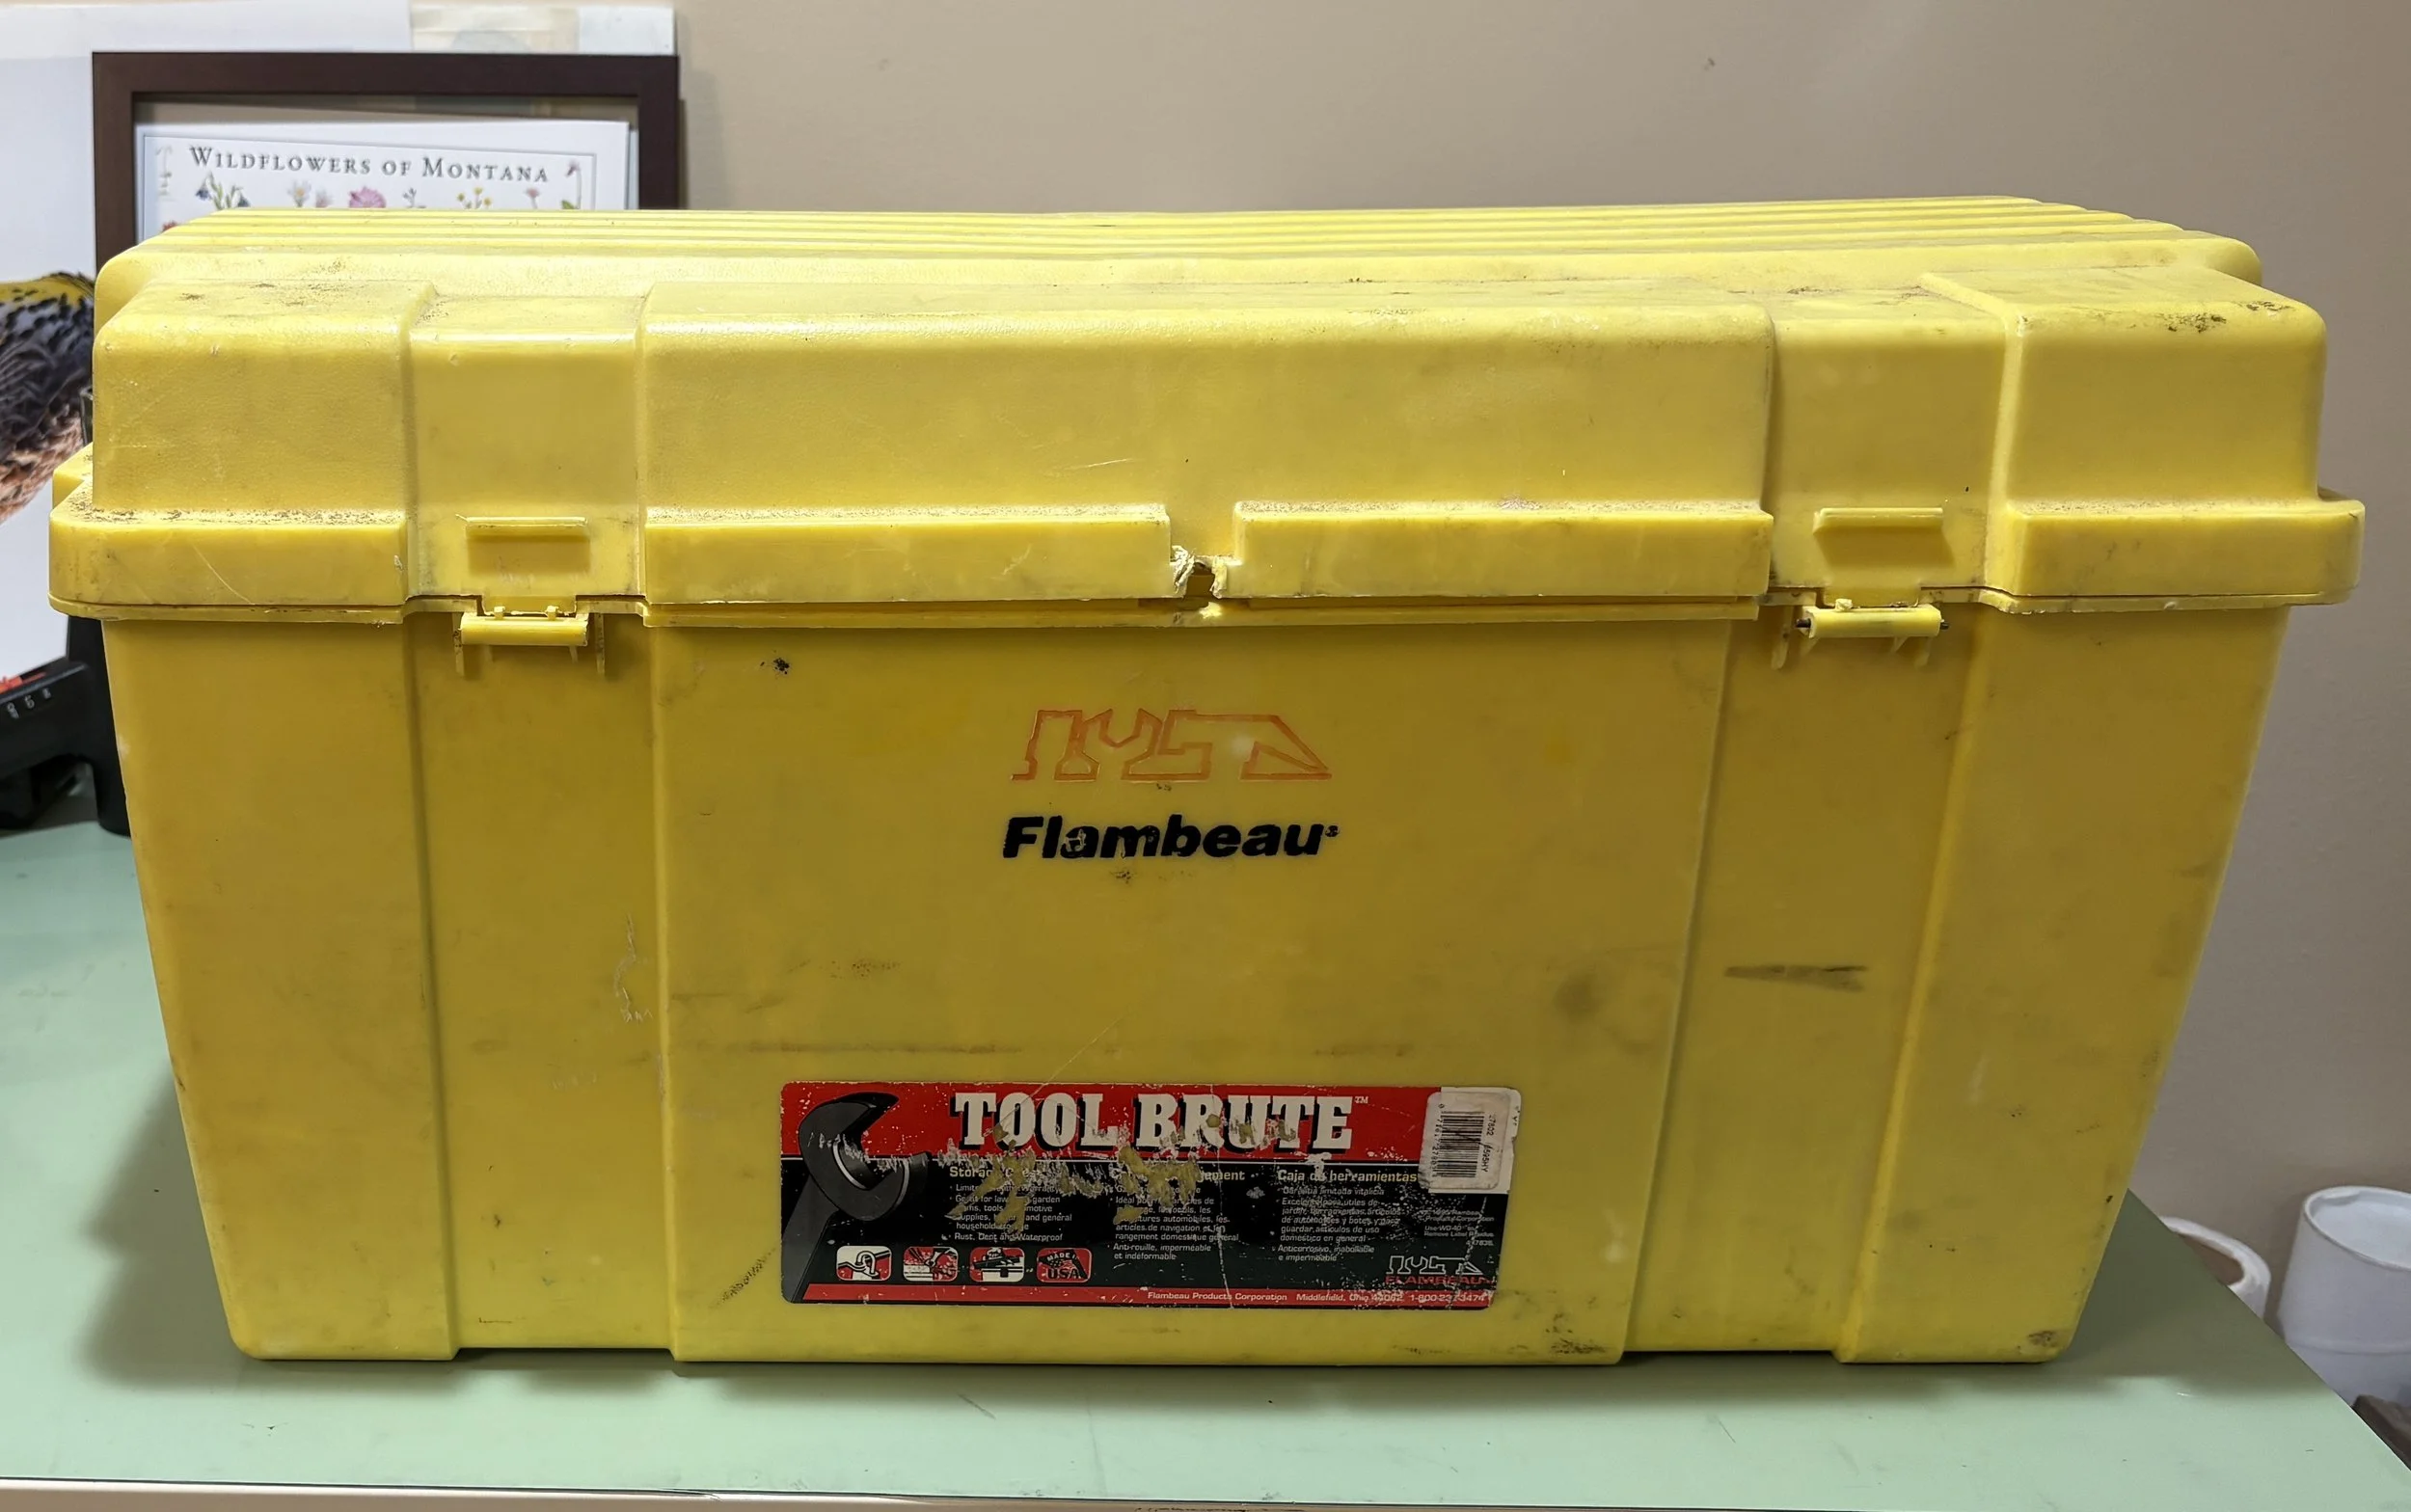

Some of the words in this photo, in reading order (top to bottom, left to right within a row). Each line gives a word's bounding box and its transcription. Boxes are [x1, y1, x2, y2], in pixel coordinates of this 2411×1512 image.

[955, 1093, 1120, 1147] TOOL
[1278, 1169, 1305, 1182] Caja
[1310, 1170, 1327, 1182] d
[1329, 1169, 1418, 1182] herramientas
[1032, 1196, 1061, 1204] garden
[959, 1214, 991, 1223] upplies,
[1046, 1253, 1070, 1261] MADE
[1234, 1292, 1287, 1302] Corporation
